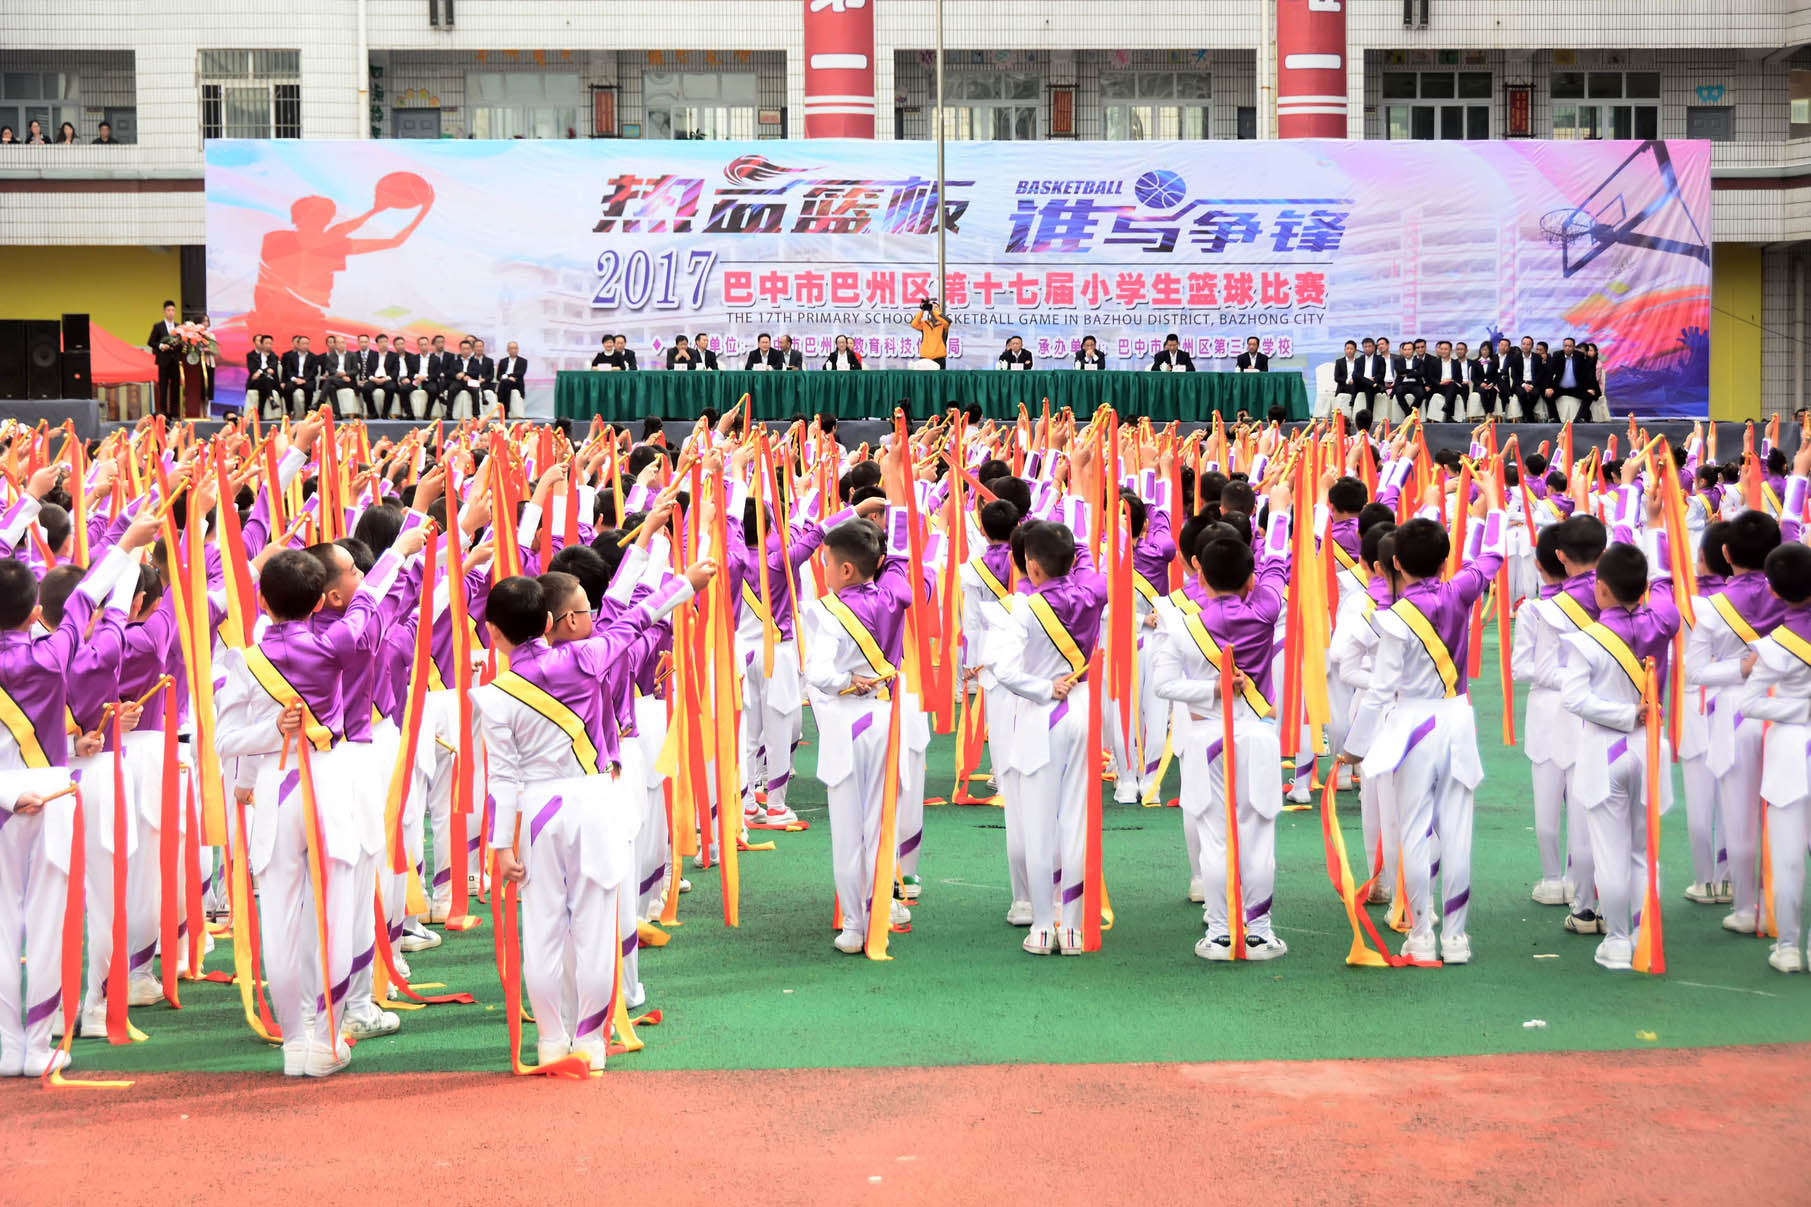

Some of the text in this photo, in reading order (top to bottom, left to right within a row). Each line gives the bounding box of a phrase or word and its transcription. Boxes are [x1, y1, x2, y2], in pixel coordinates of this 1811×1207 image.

[592, 155, 1355, 253] 热血篮板 谁与争锋
[1015, 180, 1124, 195] BASKETBALL
[592, 249, 1326, 309] 2017 巴中市巴州区第十七届小学生篮球比赛
[727, 312, 1325, 328] THE 17TH PRIMARY SCHOO KETBALL GAME IN BAZHOU DISTRICT, BAZHONG CITY
